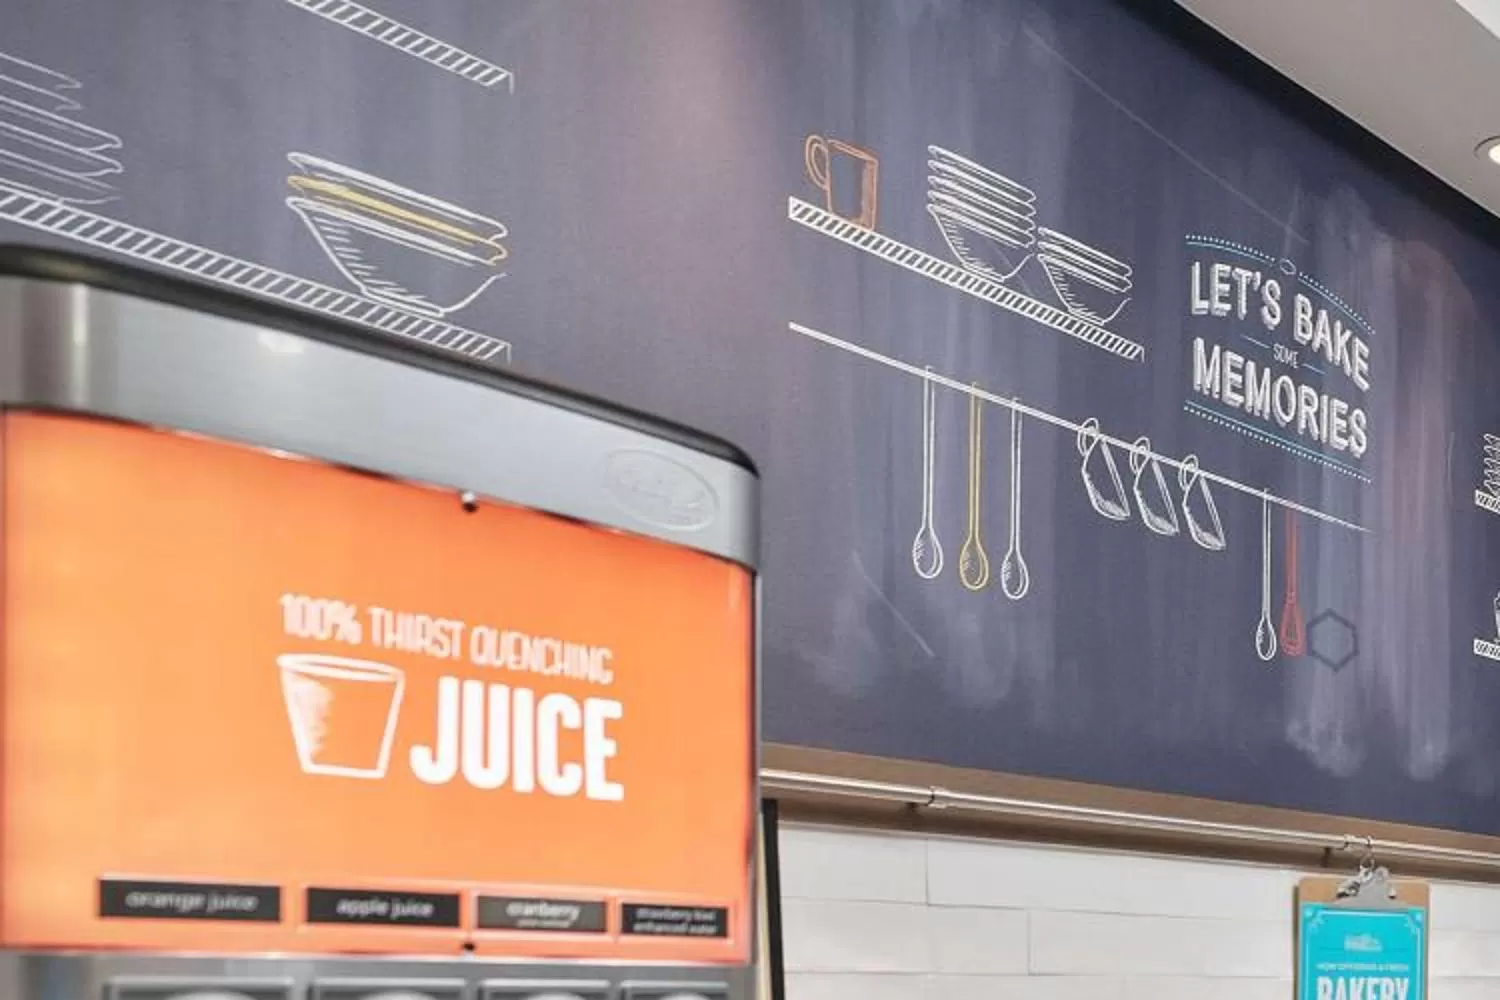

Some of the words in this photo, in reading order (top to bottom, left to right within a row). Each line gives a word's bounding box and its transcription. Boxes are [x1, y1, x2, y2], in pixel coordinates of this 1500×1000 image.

[1191, 261, 1281, 330] LET'S
[1293, 293, 1370, 391] BAKE
[1273, 343, 1299, 369] SOME
[1193, 337, 1367, 458] MEMORIES
[280, 593, 362, 644] 100%
[368, 605, 466, 661] THIRST
[470, 626, 615, 685] QUENCHING
[409, 675, 625, 801] JUICE
[125, 891, 206, 913] orange
[207, 891, 259, 914] juice
[336, 897, 388, 917] apple
[391, 898, 435, 919] juice
[506, 901, 580, 922] cranberry
